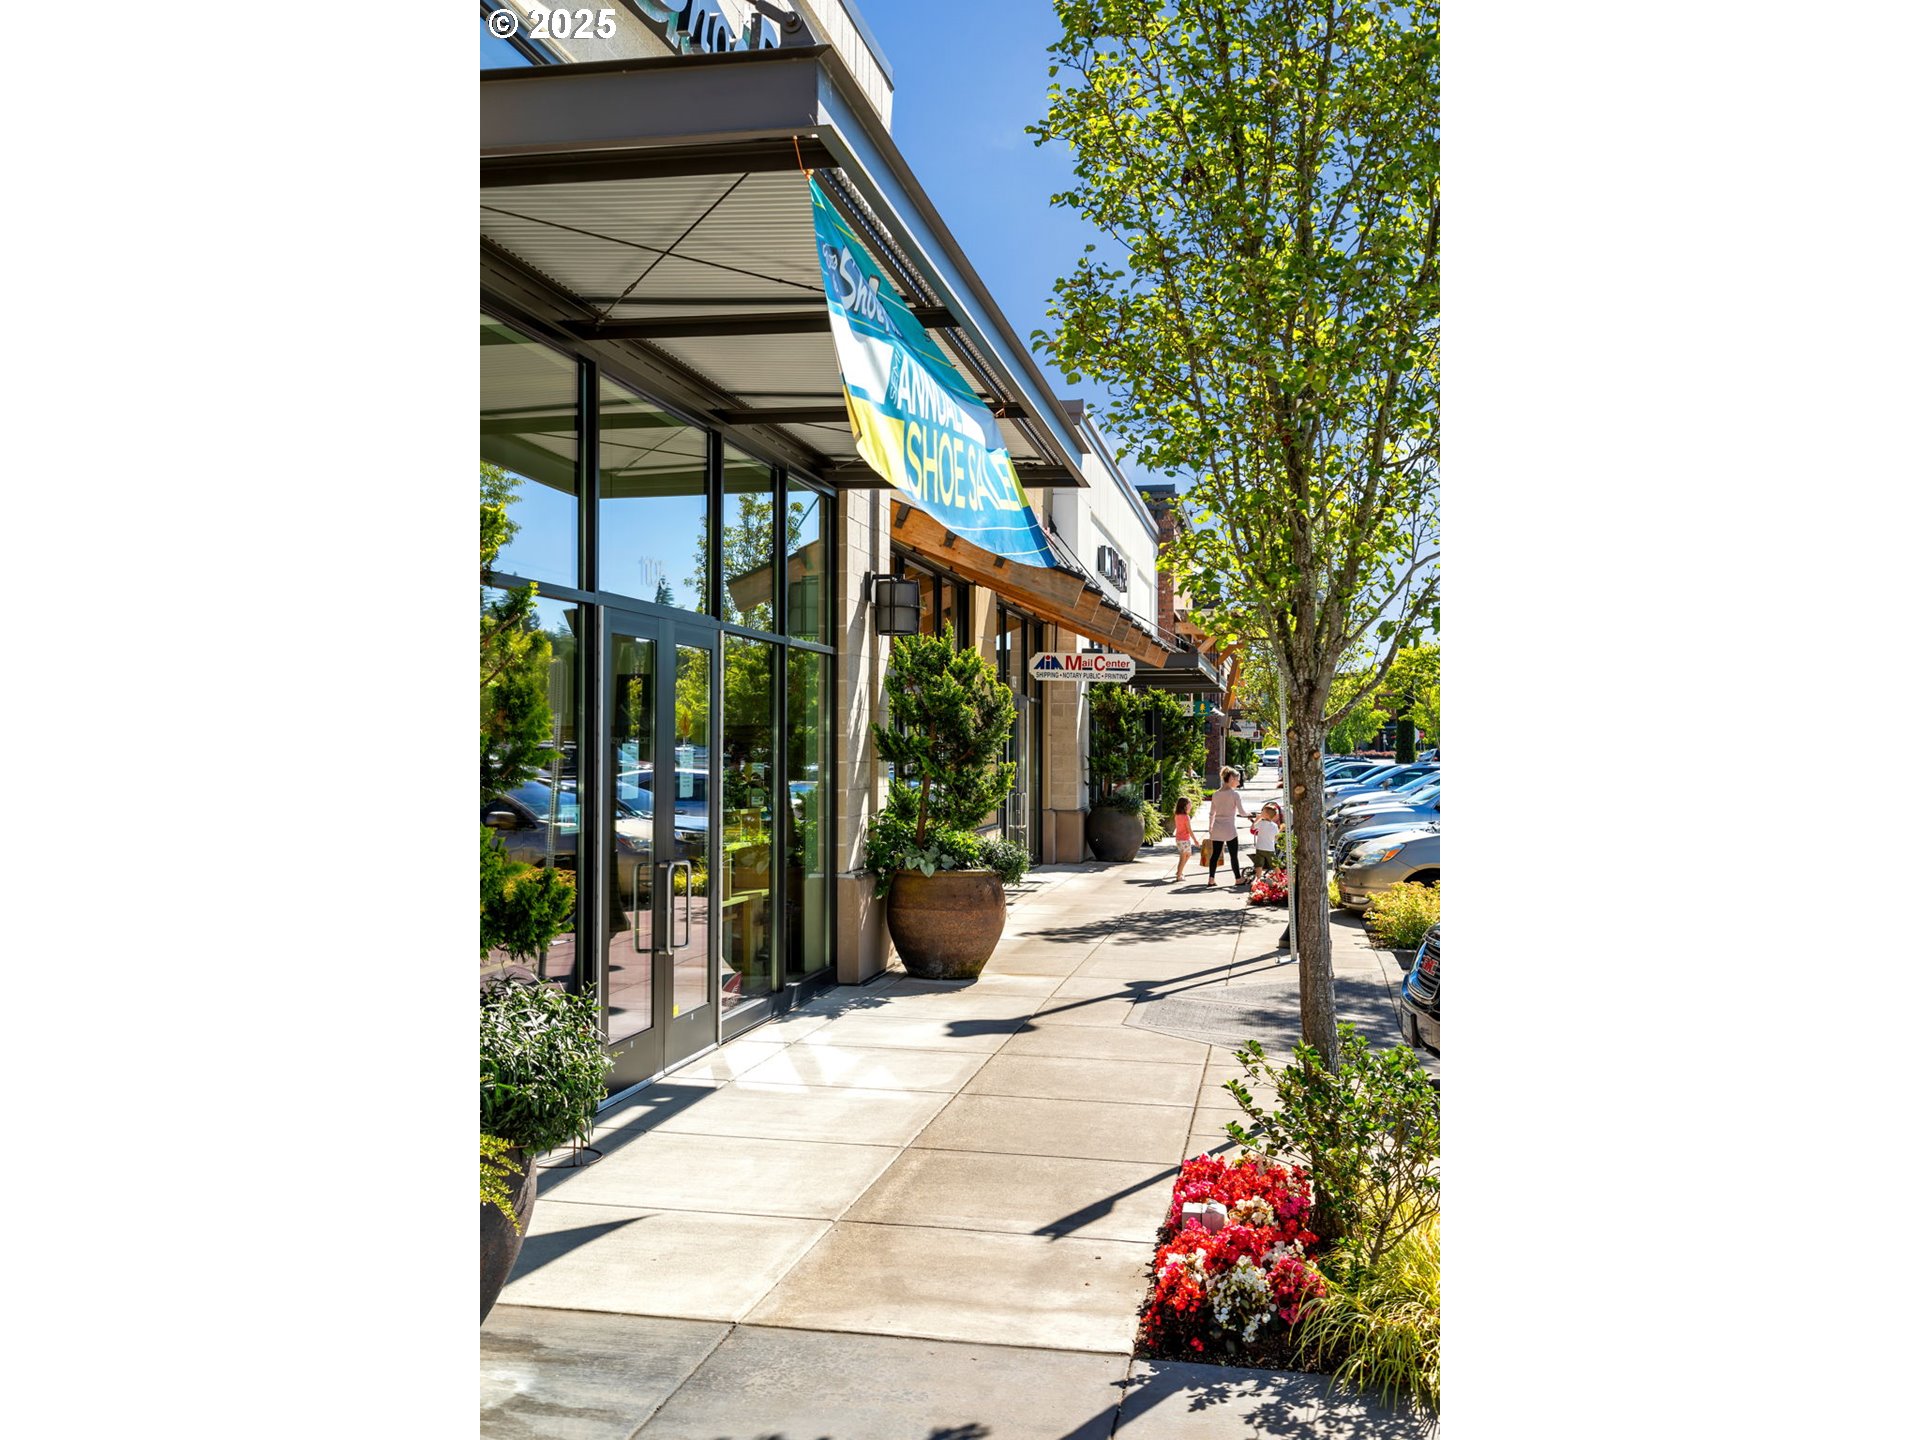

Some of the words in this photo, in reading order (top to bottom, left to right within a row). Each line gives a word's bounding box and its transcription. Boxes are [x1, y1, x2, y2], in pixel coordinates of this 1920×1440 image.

[906, 421, 966, 509] SHOE
[968, 444, 1022, 511] SALE
[1035, 671, 1060, 679] SHIPPING
